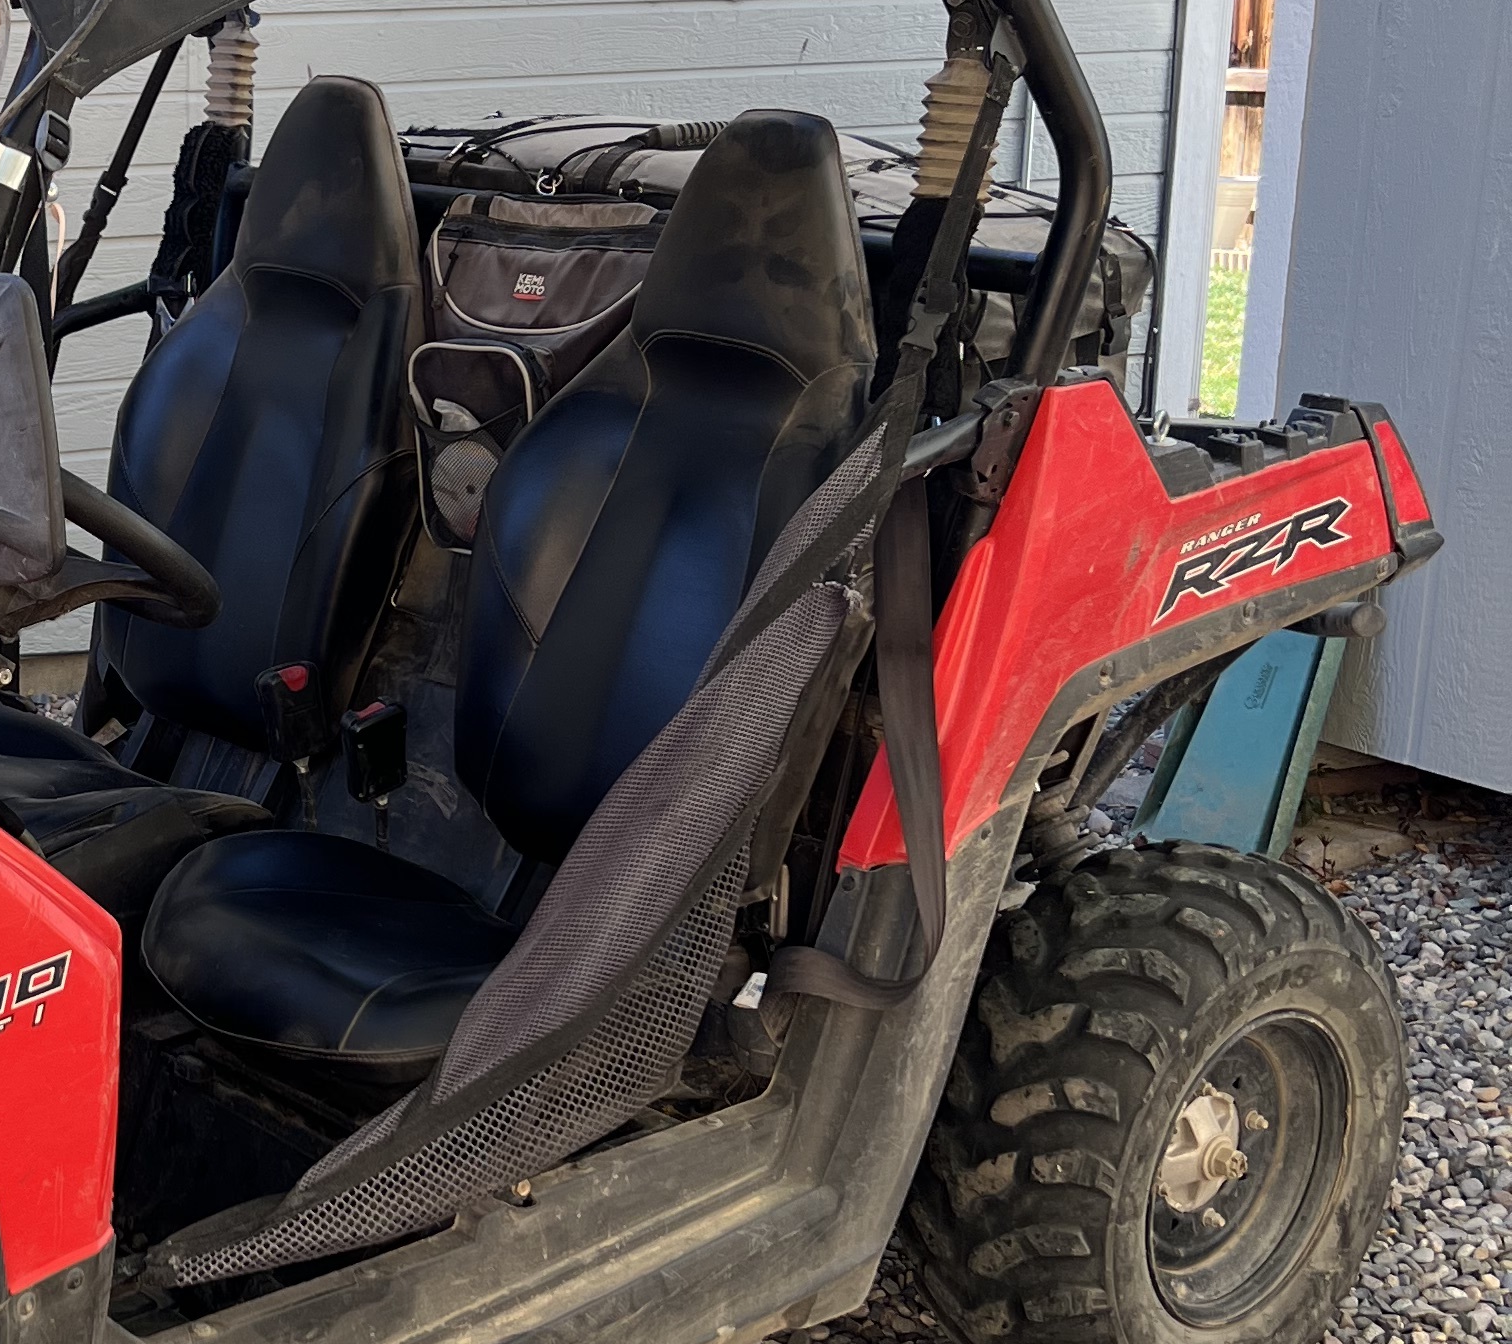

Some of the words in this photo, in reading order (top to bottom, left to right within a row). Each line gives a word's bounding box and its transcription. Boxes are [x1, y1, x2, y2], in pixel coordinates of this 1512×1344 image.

[513, 284, 545, 296] MOTO
[517, 273, 545, 286] KEMI
[1180, 512, 1262, 555] RANGER
[1151, 496, 1353, 627] RZR
